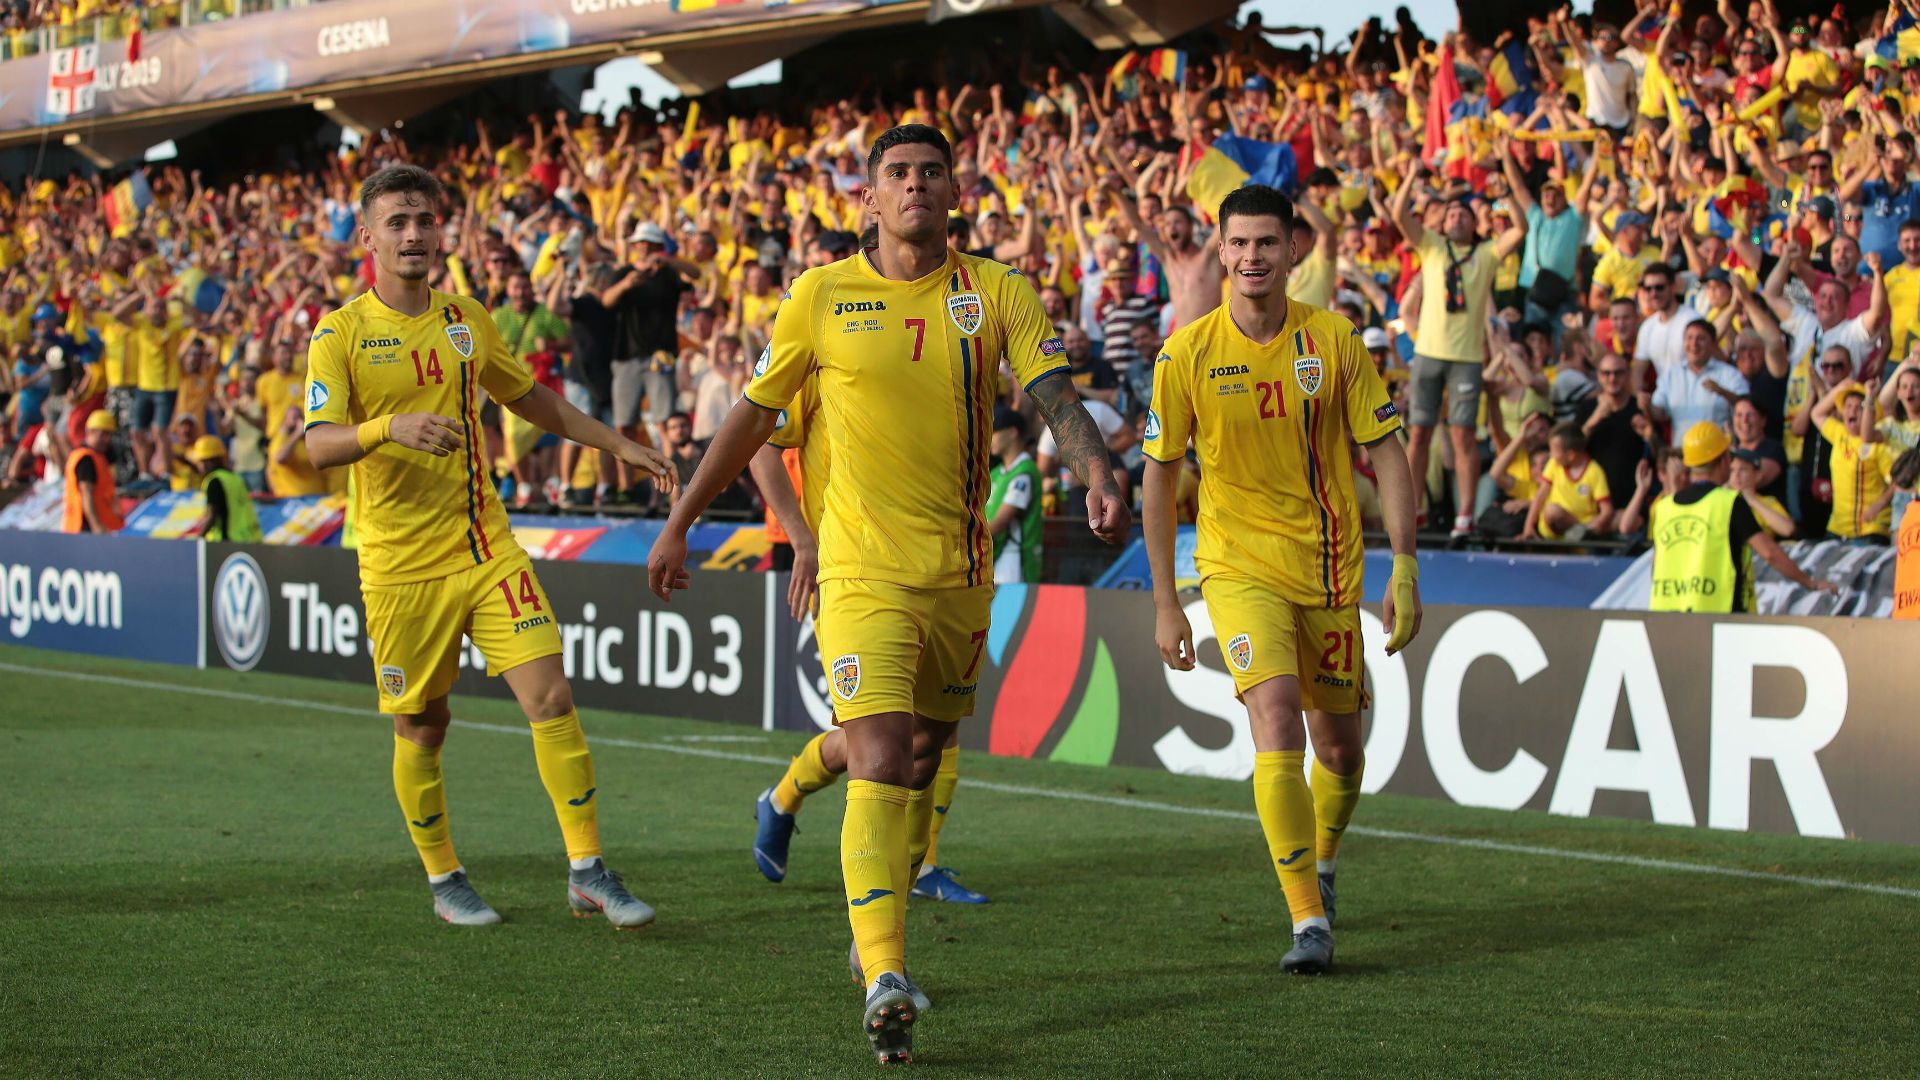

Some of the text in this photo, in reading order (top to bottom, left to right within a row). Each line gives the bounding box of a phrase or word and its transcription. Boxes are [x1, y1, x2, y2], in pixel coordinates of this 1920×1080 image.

[317, 17, 390, 56] CESENA
[120, 56, 161, 88] 2019
[904, 318, 926, 362] 7
[411, 348, 444, 386] 14
[1256, 381, 1287, 419] 21
[499, 570, 542, 619] 14
[281, 582, 358, 657] The
[637, 608, 742, 696] ID.3
[961, 627, 987, 680] 7
[1320, 630, 1353, 673] 21
